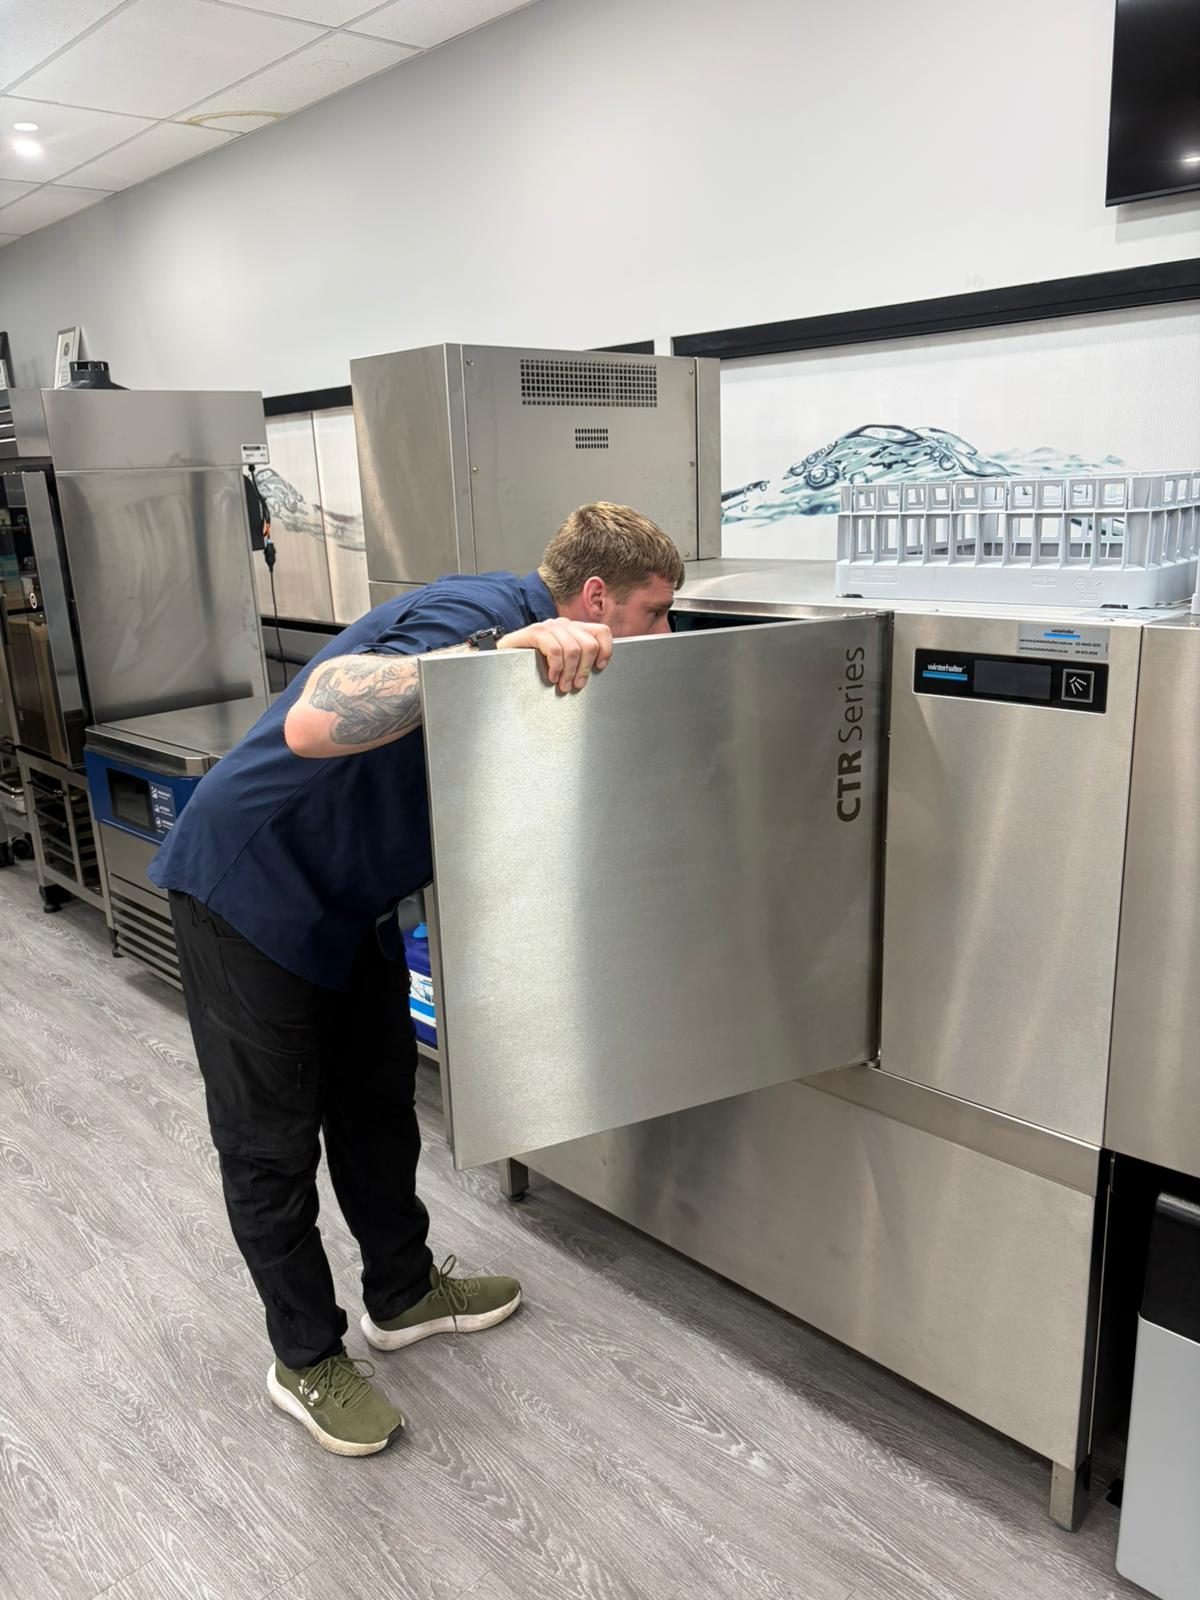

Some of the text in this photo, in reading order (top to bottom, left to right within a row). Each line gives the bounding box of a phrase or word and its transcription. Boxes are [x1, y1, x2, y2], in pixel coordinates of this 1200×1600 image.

[927, 662, 963, 673] winterhalter
[837, 647, 865, 822] CTR Series
